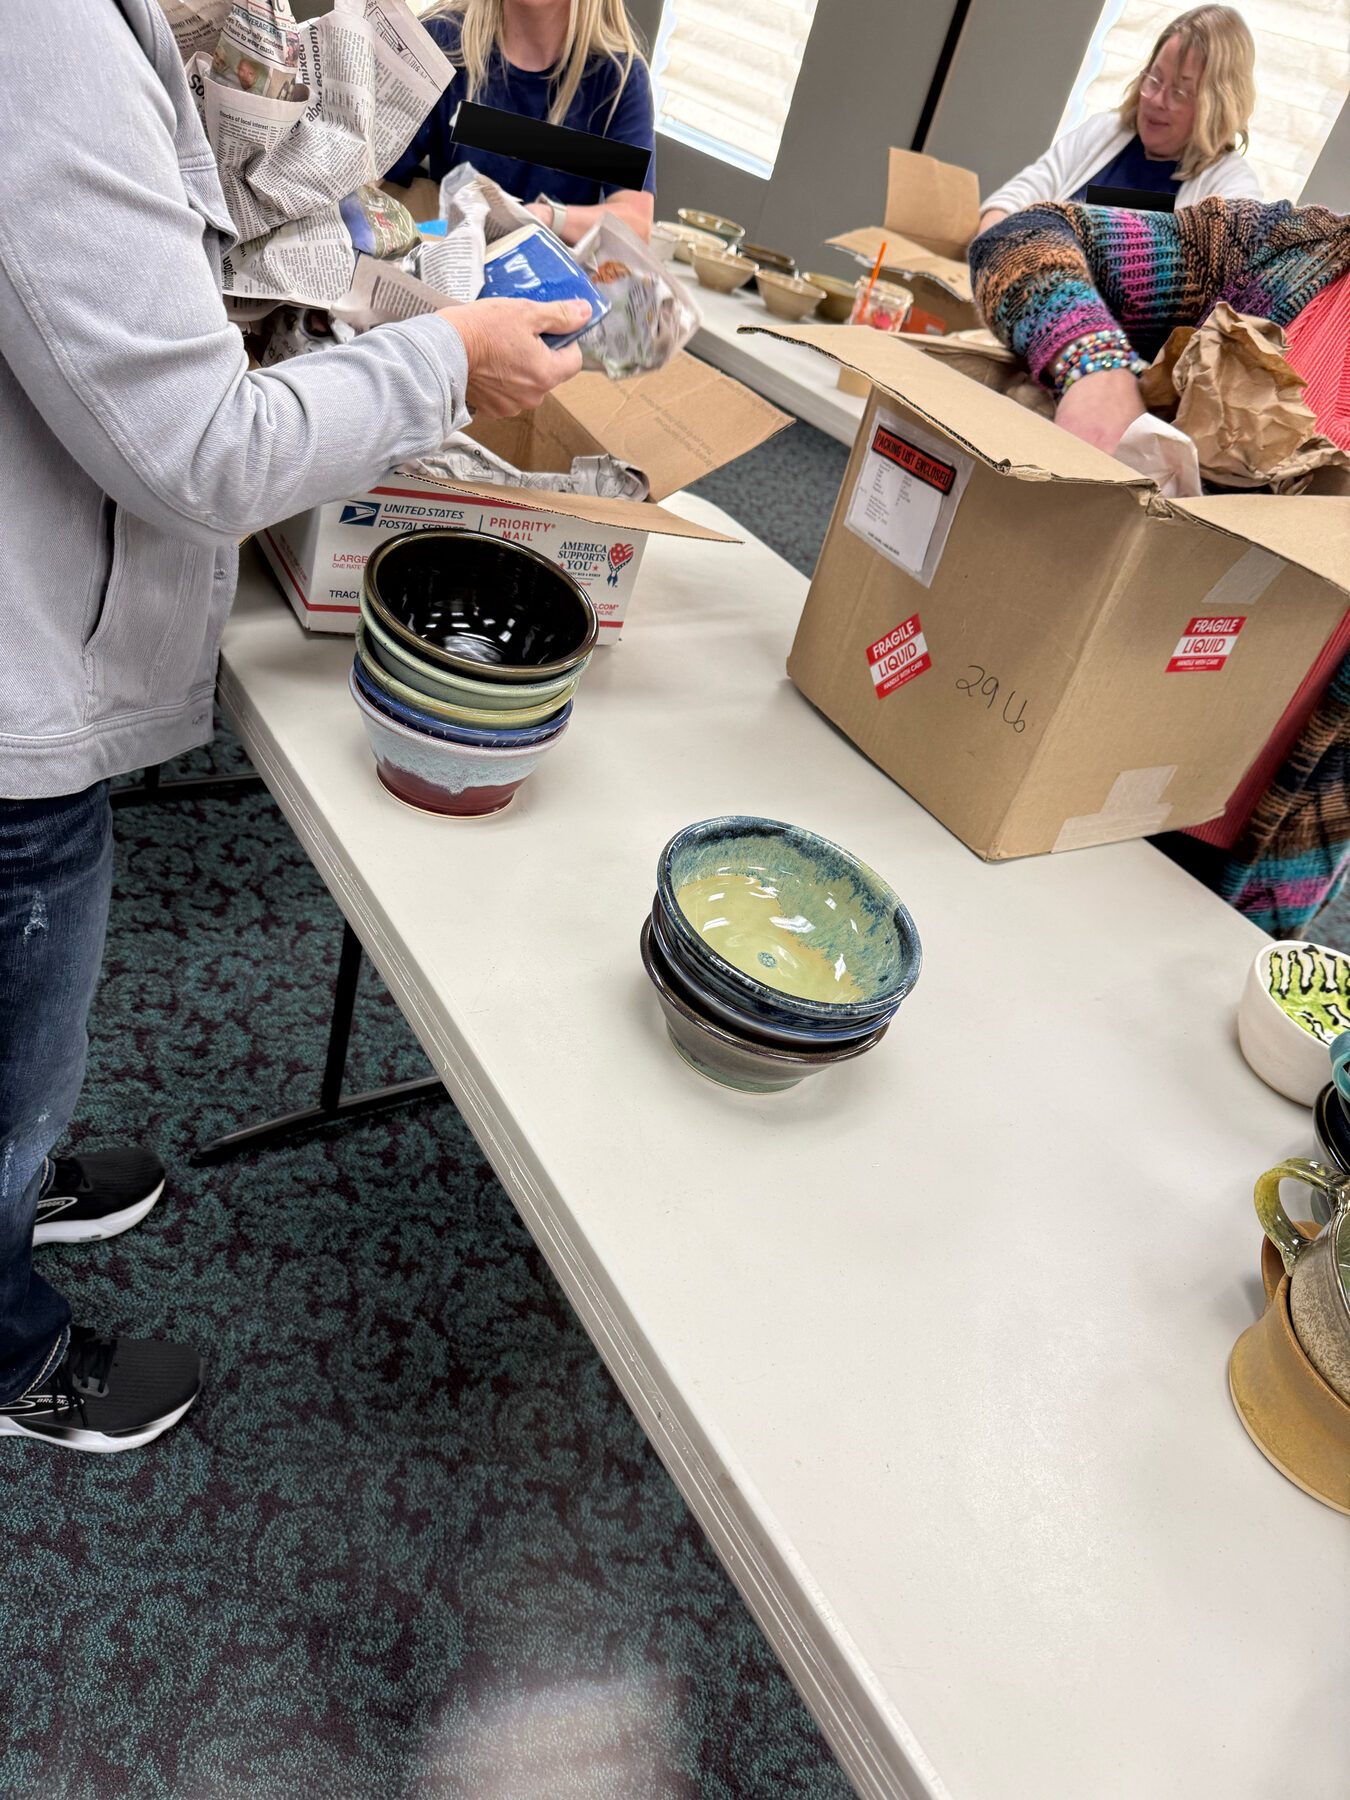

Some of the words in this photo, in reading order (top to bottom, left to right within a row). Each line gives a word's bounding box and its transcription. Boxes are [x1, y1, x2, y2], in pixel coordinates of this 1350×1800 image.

[309, 24, 322, 87] economy
[901, 449, 915, 466] LIST
[915, 457, 950, 486] ENCLOSED
[384, 503, 425, 516] UNITED
[426, 508, 465, 519] STATES
[378, 519, 417, 531] POSTAL
[502, 530, 533, 542] MAIL
[560, 541, 607, 554] AMERICA
[333, 553, 368, 564] LARGE
[558, 550, 606, 562] SUPPORTS
[566, 559, 593, 571] YOU
[1192, 619, 1240, 633] FRAGILE
[872, 620, 915, 659] FRAGILE
[1182, 638, 1226, 654] LIQUID
[878, 642, 917, 678] LIQUID
[955, 665, 999, 709] 29
